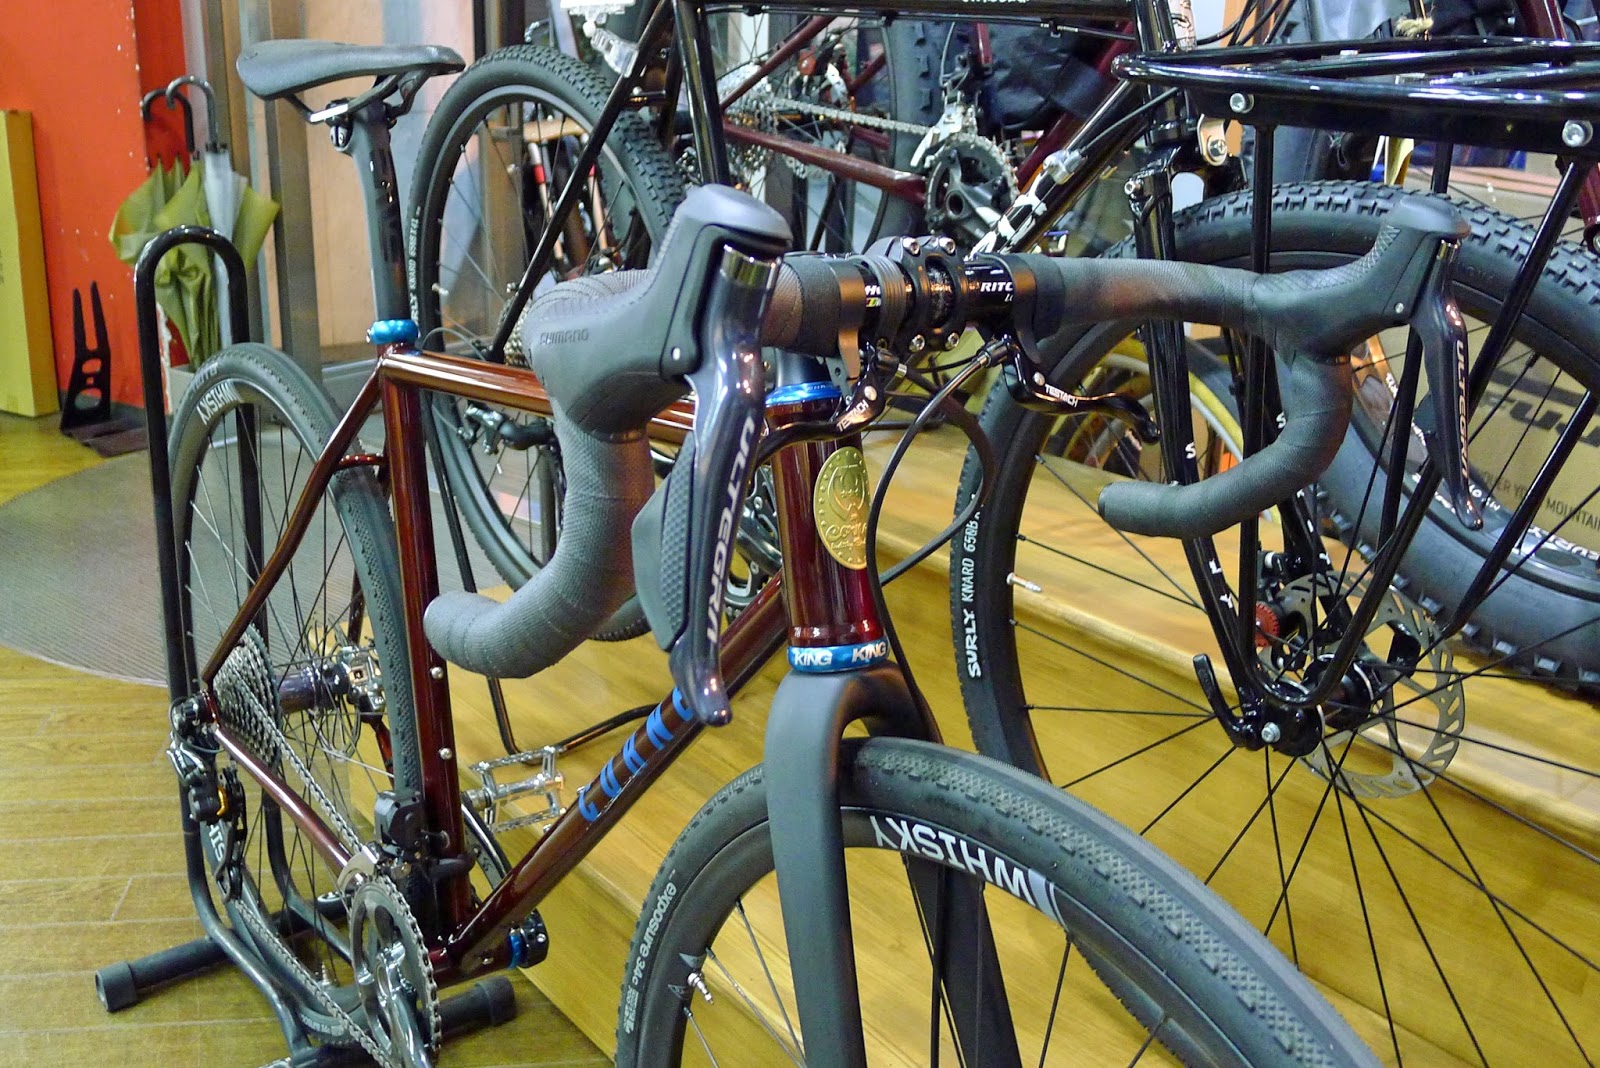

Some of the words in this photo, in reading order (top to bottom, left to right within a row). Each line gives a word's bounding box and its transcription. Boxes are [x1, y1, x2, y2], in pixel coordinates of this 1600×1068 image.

[980, 281, 1014, 293] RITC
[540, 328, 589, 345] SHIMANO
[195, 382, 235, 426] WHISKY
[836, 399, 870, 432] TESTACH
[1044, 383, 1079, 408] TESTACH
[1456, 339, 1468, 478] ULTEGRA
[706, 416, 756, 645] ULTEGRA
[961, 557, 976, 603] KNARD
[794, 649, 834, 666] KING
[851, 641, 887, 663] KING
[962, 608, 982, 678] SURLY
[869, 815, 1037, 908] WHISKY
[639, 882, 678, 958] exposure
[631, 955, 647, 986] 34c
